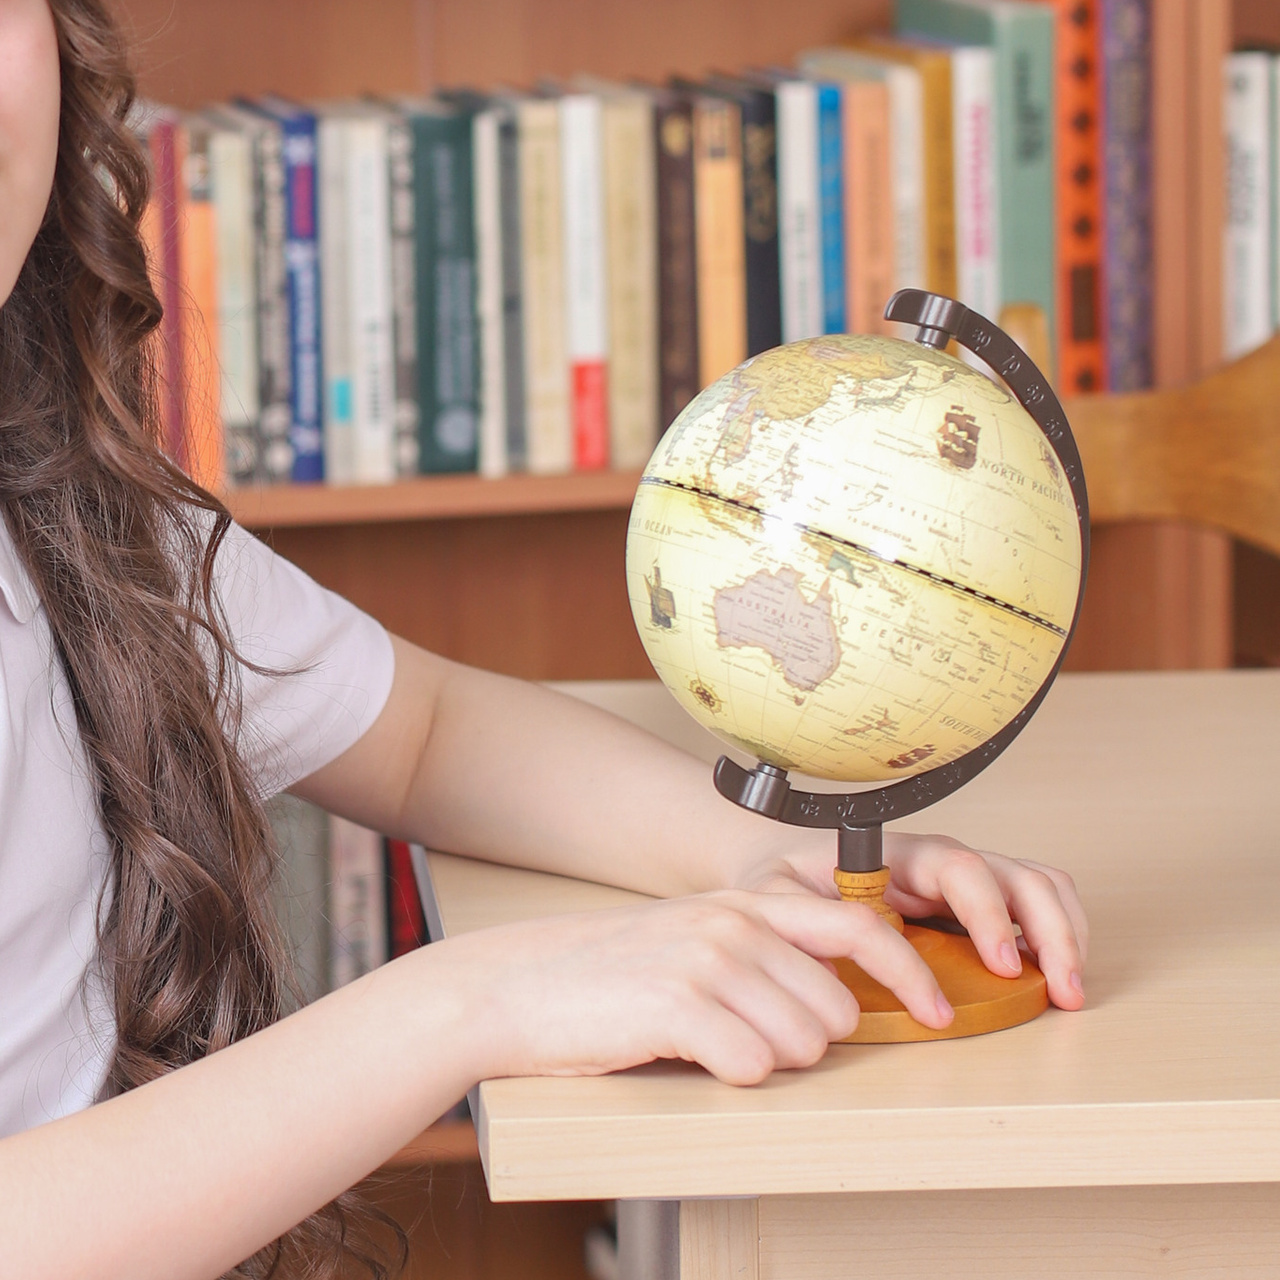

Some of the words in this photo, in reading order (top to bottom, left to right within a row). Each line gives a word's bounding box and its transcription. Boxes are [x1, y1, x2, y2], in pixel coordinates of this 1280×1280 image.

[1002, 354, 1020, 374] 70
[979, 459, 1025, 486] NORTH
[1031, 481, 1066, 506] PACIFIC
[644, 519, 673, 536] OCEAN
[738, 597, 810, 629] AUSTRALIA
[939, 715, 976, 736] SOUTH
